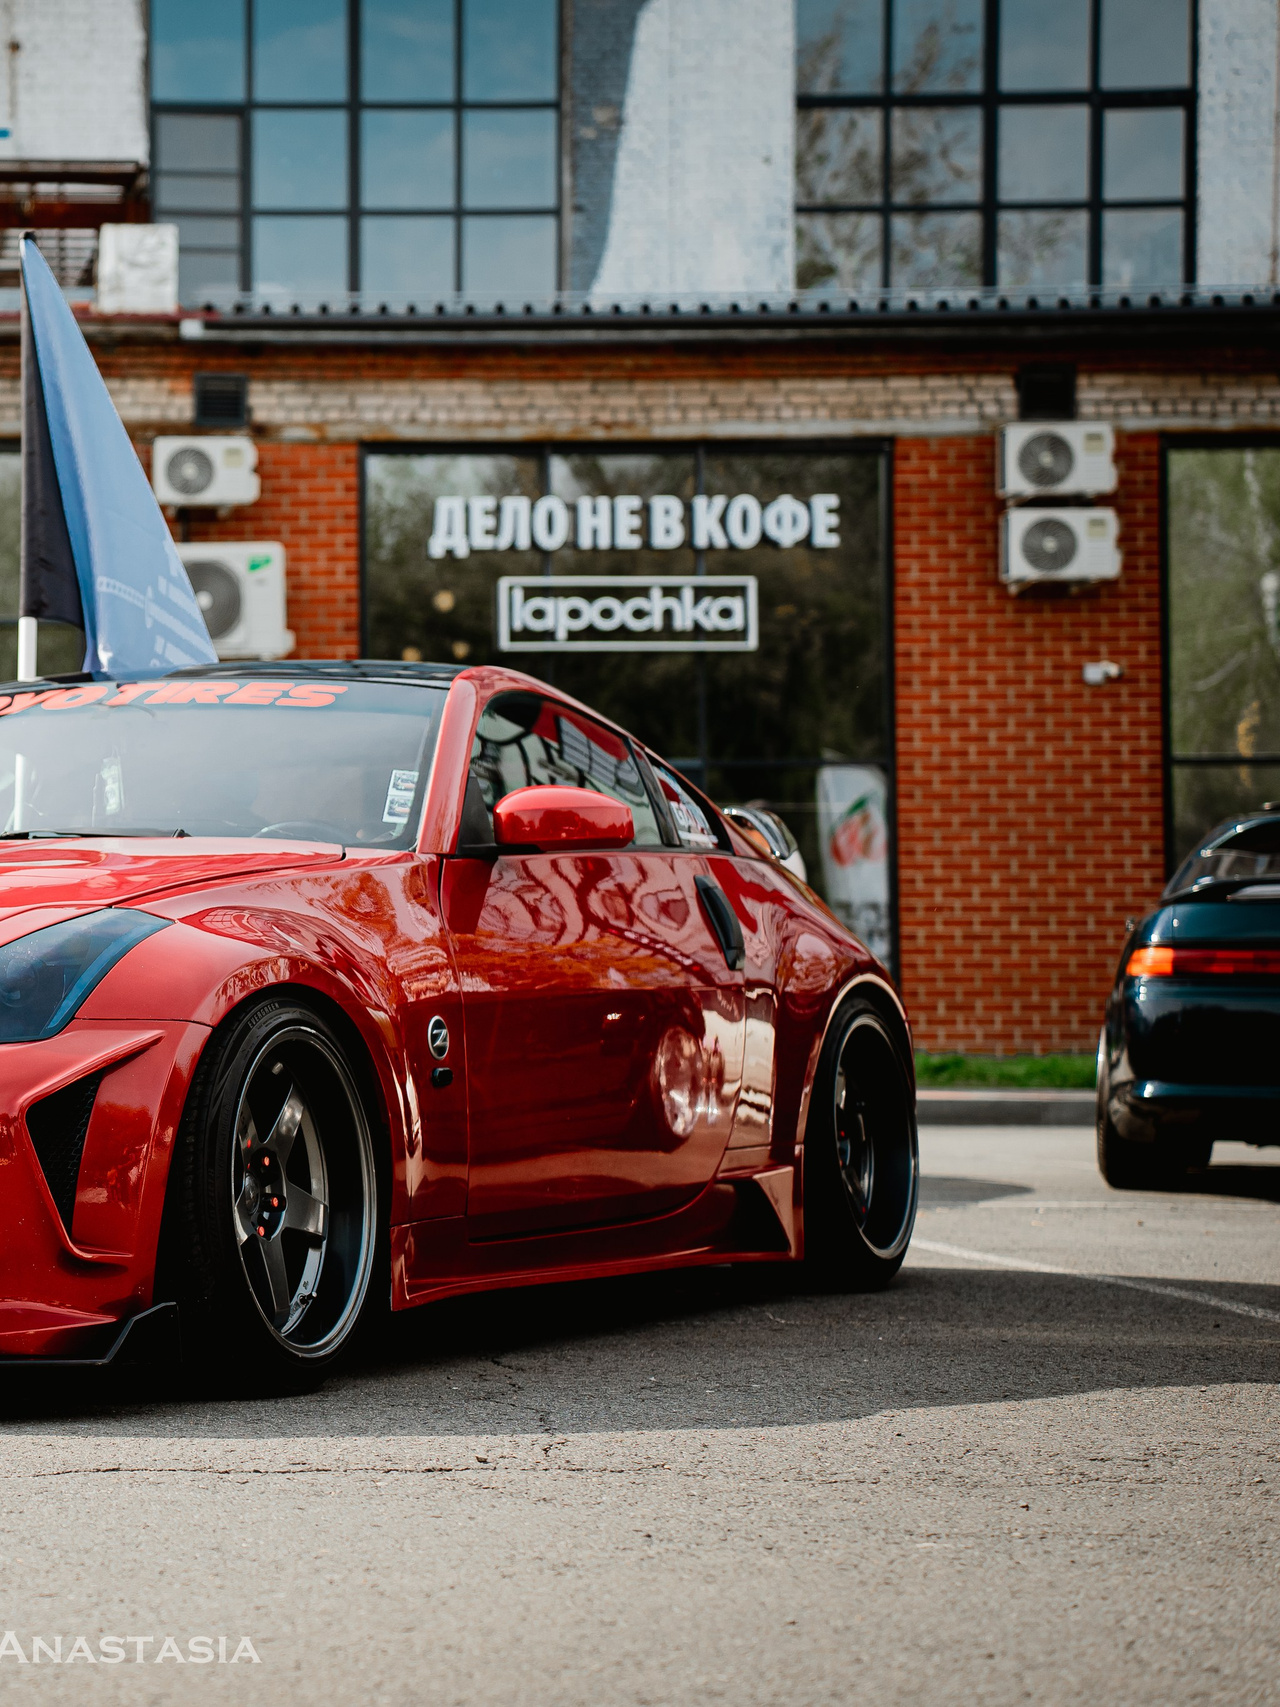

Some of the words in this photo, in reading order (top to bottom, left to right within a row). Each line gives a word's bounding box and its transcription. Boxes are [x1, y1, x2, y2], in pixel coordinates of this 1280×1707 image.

[428, 495, 569, 559] ДЕЛО
[577, 495, 643, 549] НЕ
[650, 495, 686, 549] В
[692, 493, 841, 549] КОФЕ
[511, 585, 745, 641] lapochka
[106, 681, 349, 707] TIRES
[247, 1002, 280, 1029] EVERGREEN
